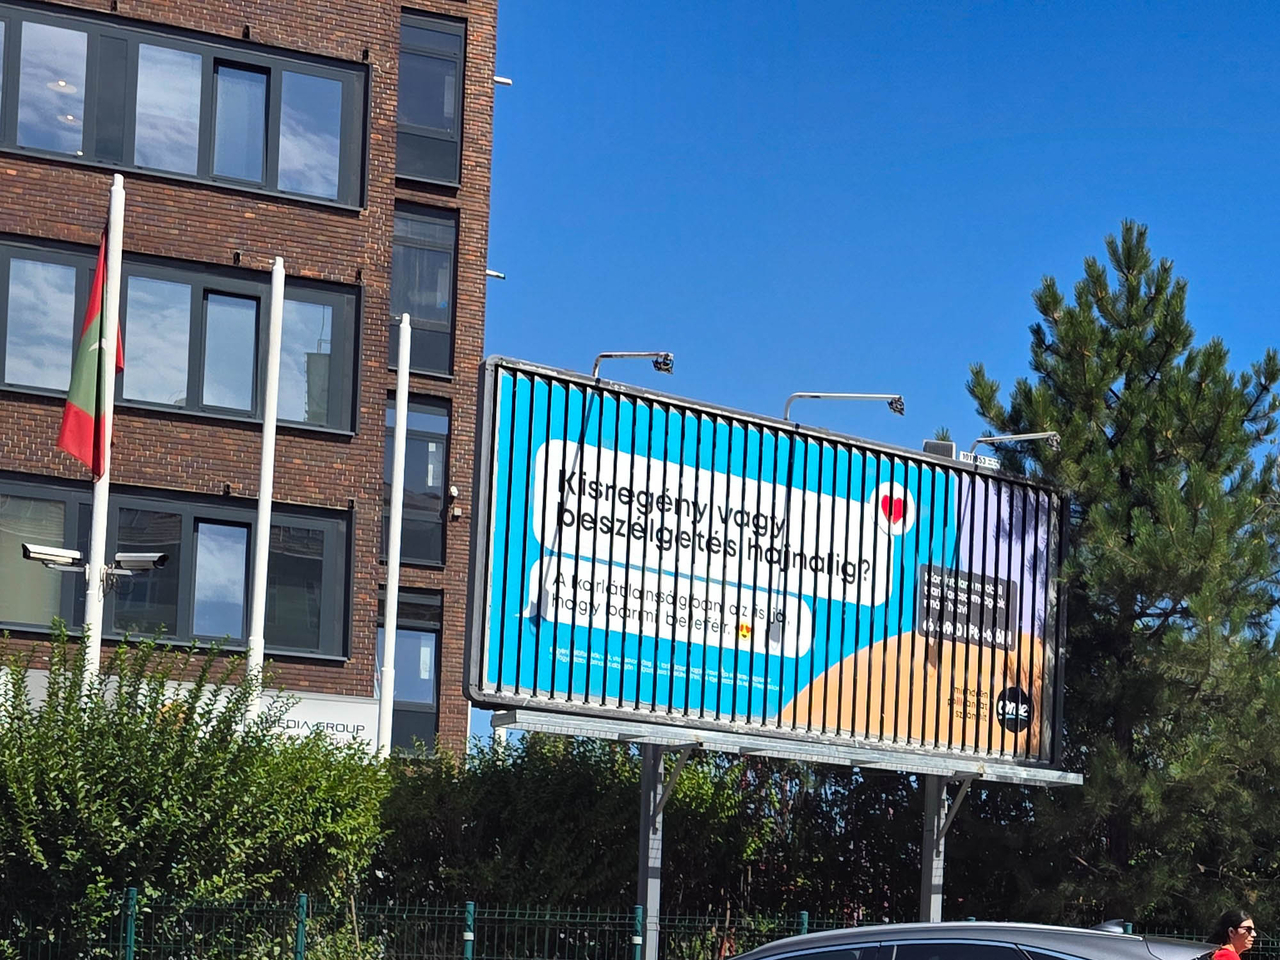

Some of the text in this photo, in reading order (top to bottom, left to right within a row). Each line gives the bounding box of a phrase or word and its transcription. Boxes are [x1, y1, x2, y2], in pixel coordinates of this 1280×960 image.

[558, 469, 786, 539] Kisregény vagy
[556, 501, 871, 585] beszélgetés hajnalig?
[551, 592, 601, 616] hogy
[665, 611, 730, 635] beefér.
[552, 572, 567, 588] A
[729, 604, 748, 618] az
